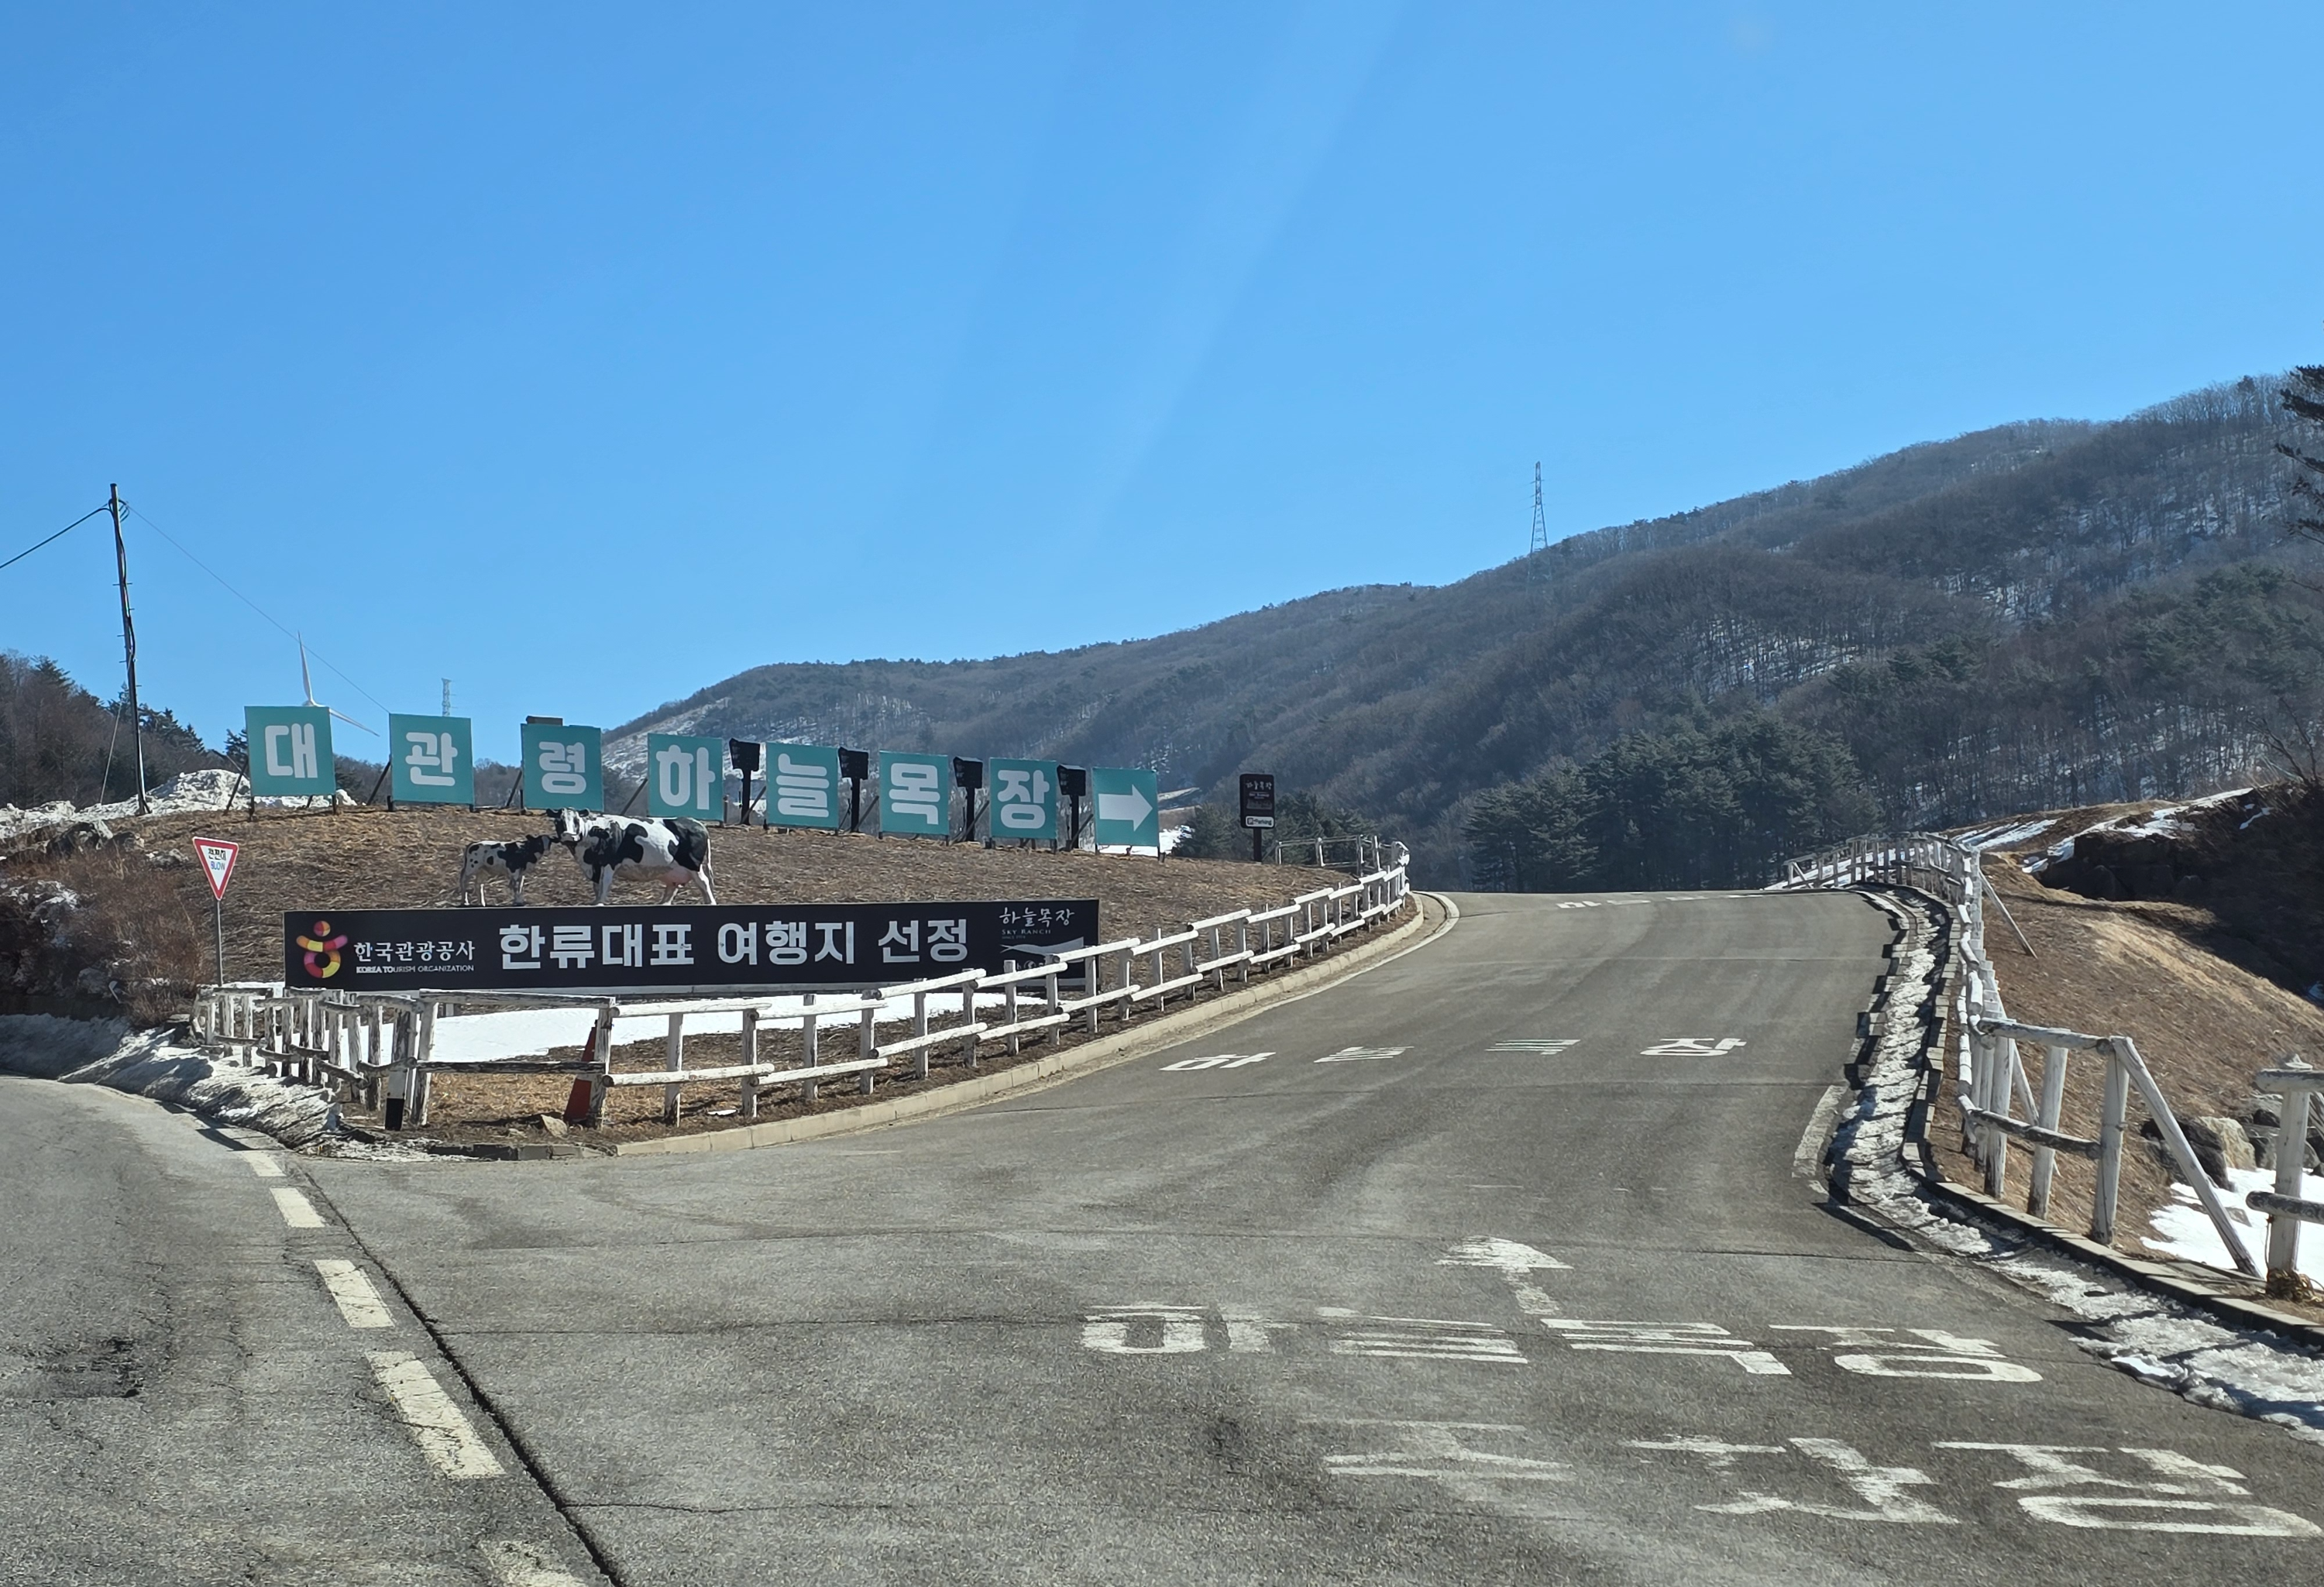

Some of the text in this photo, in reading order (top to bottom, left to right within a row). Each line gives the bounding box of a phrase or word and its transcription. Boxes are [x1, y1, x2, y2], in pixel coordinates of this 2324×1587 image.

[208, 848, 226, 860] 천천히
[999, 906, 1075, 928] 하늘목장
[353, 940, 476, 963] 한국관광공사
[498, 918, 969, 970] 한류대표 여행지 선정
[383, 965, 416, 974] TOURISM
[417, 964, 474, 973] ORGANIZATION
[1158, 1038, 1747, 1071] 하늘목장
[1082, 1303, 2043, 1383] 하늘목장
